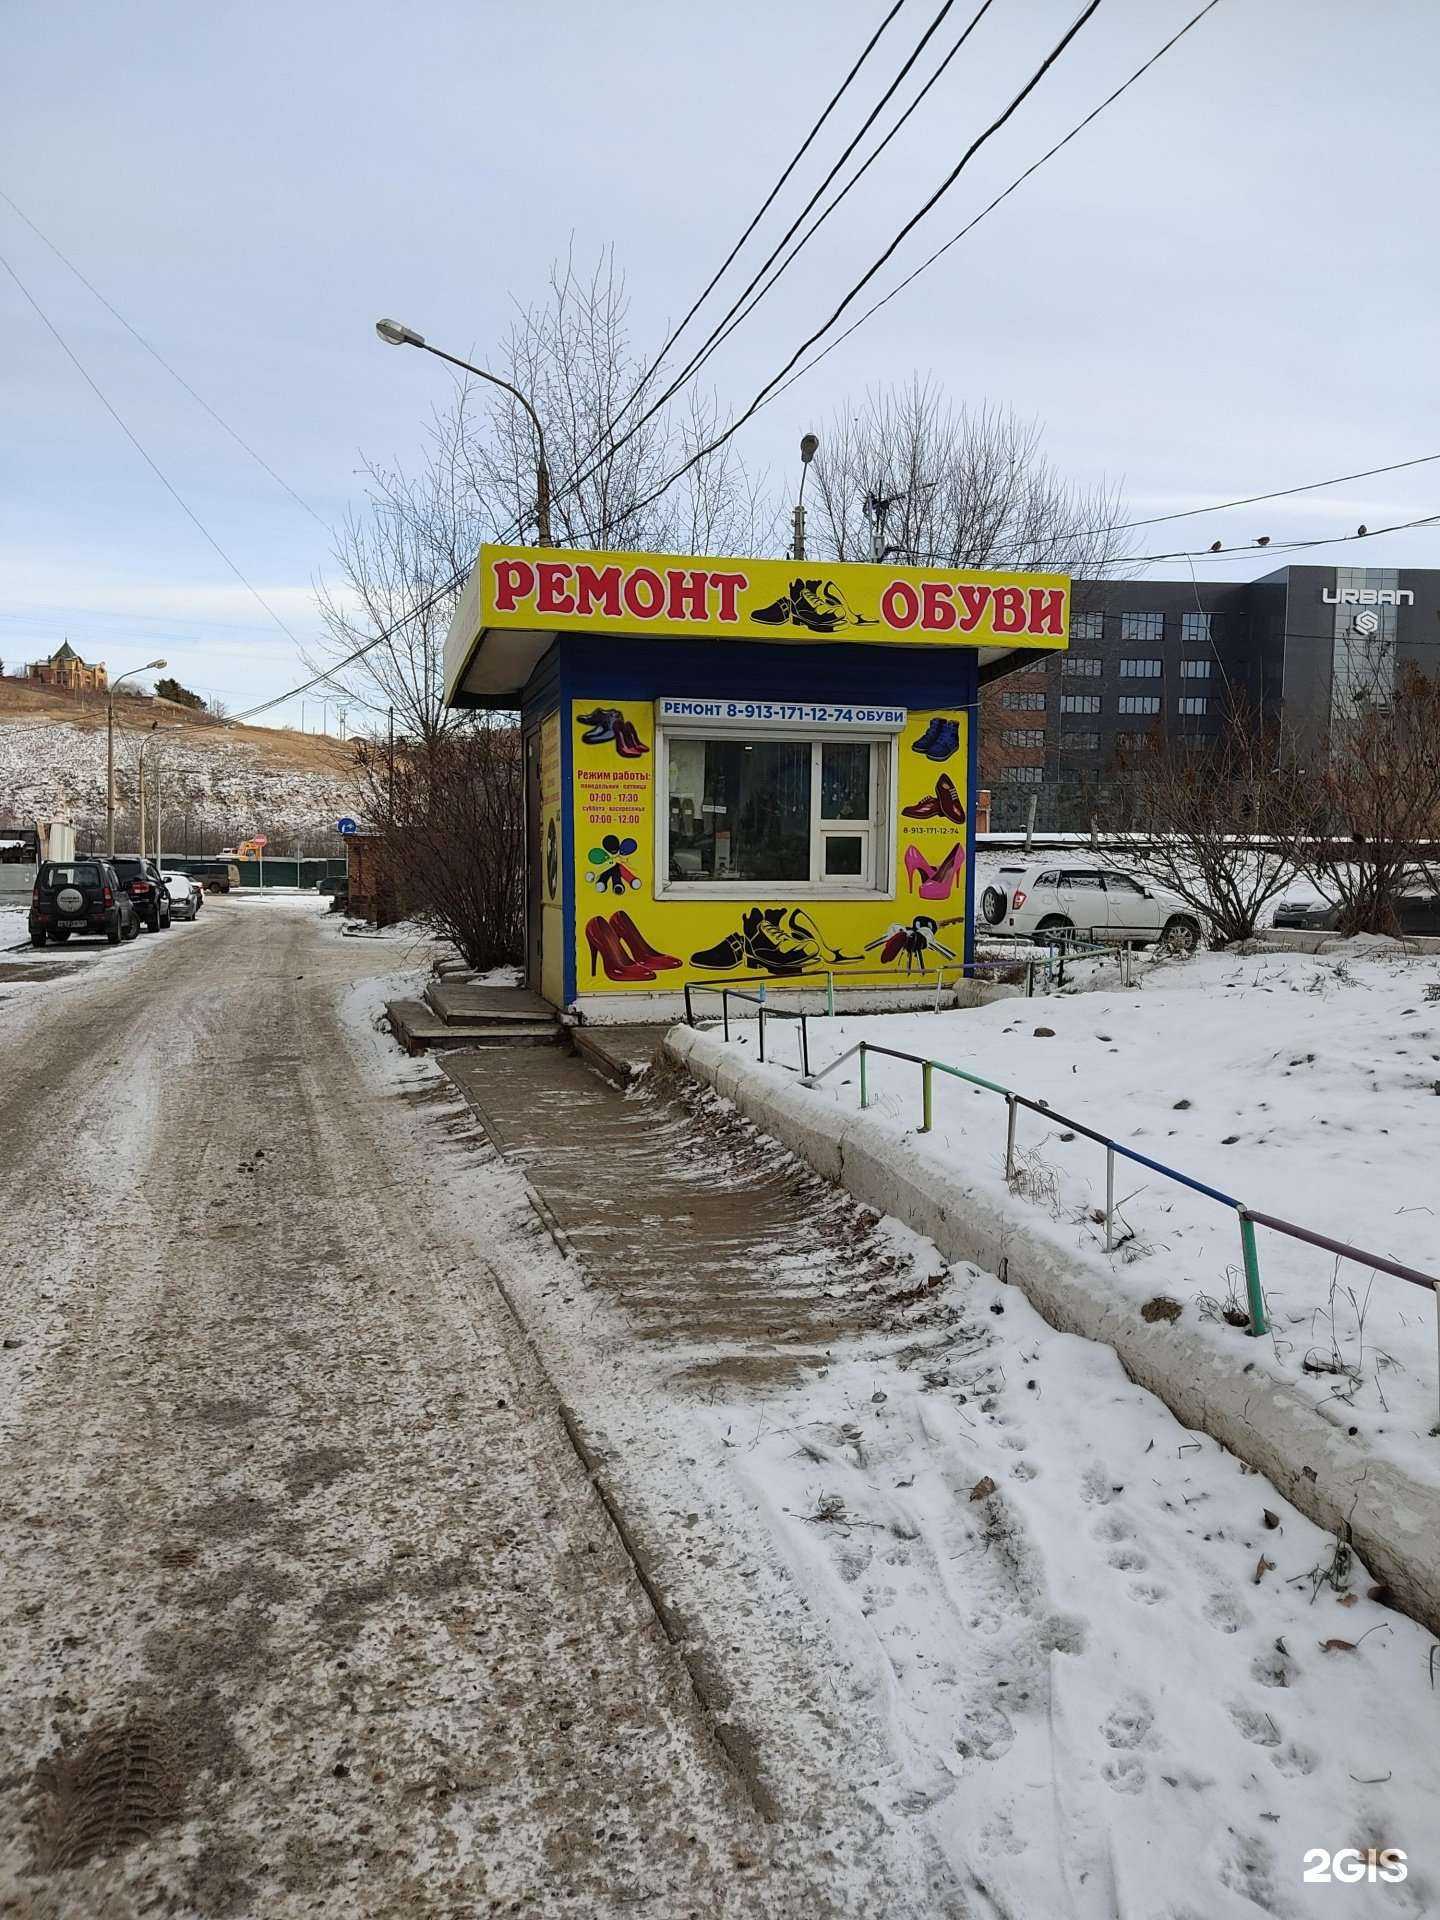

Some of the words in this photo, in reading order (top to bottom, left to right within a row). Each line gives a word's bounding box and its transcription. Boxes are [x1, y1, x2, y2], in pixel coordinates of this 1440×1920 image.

[493, 559, 749, 623] РЕМОНТ
[881, 580, 1067, 635] ОБУВИ
[1322, 587, 1415, 606] URBAN
[664, 702, 722, 716] РЕМОНТ
[726, 703, 853, 722] 8-913-171-12-74
[855, 710, 904, 722] ОБУВИ
[577, 770, 611, 780] Режим
[589, 793, 612, 802] 07:00
[618, 793, 639, 802] 17:30
[589, 815, 612, 824] 07:00
[618, 815, 640, 824] 12:00
